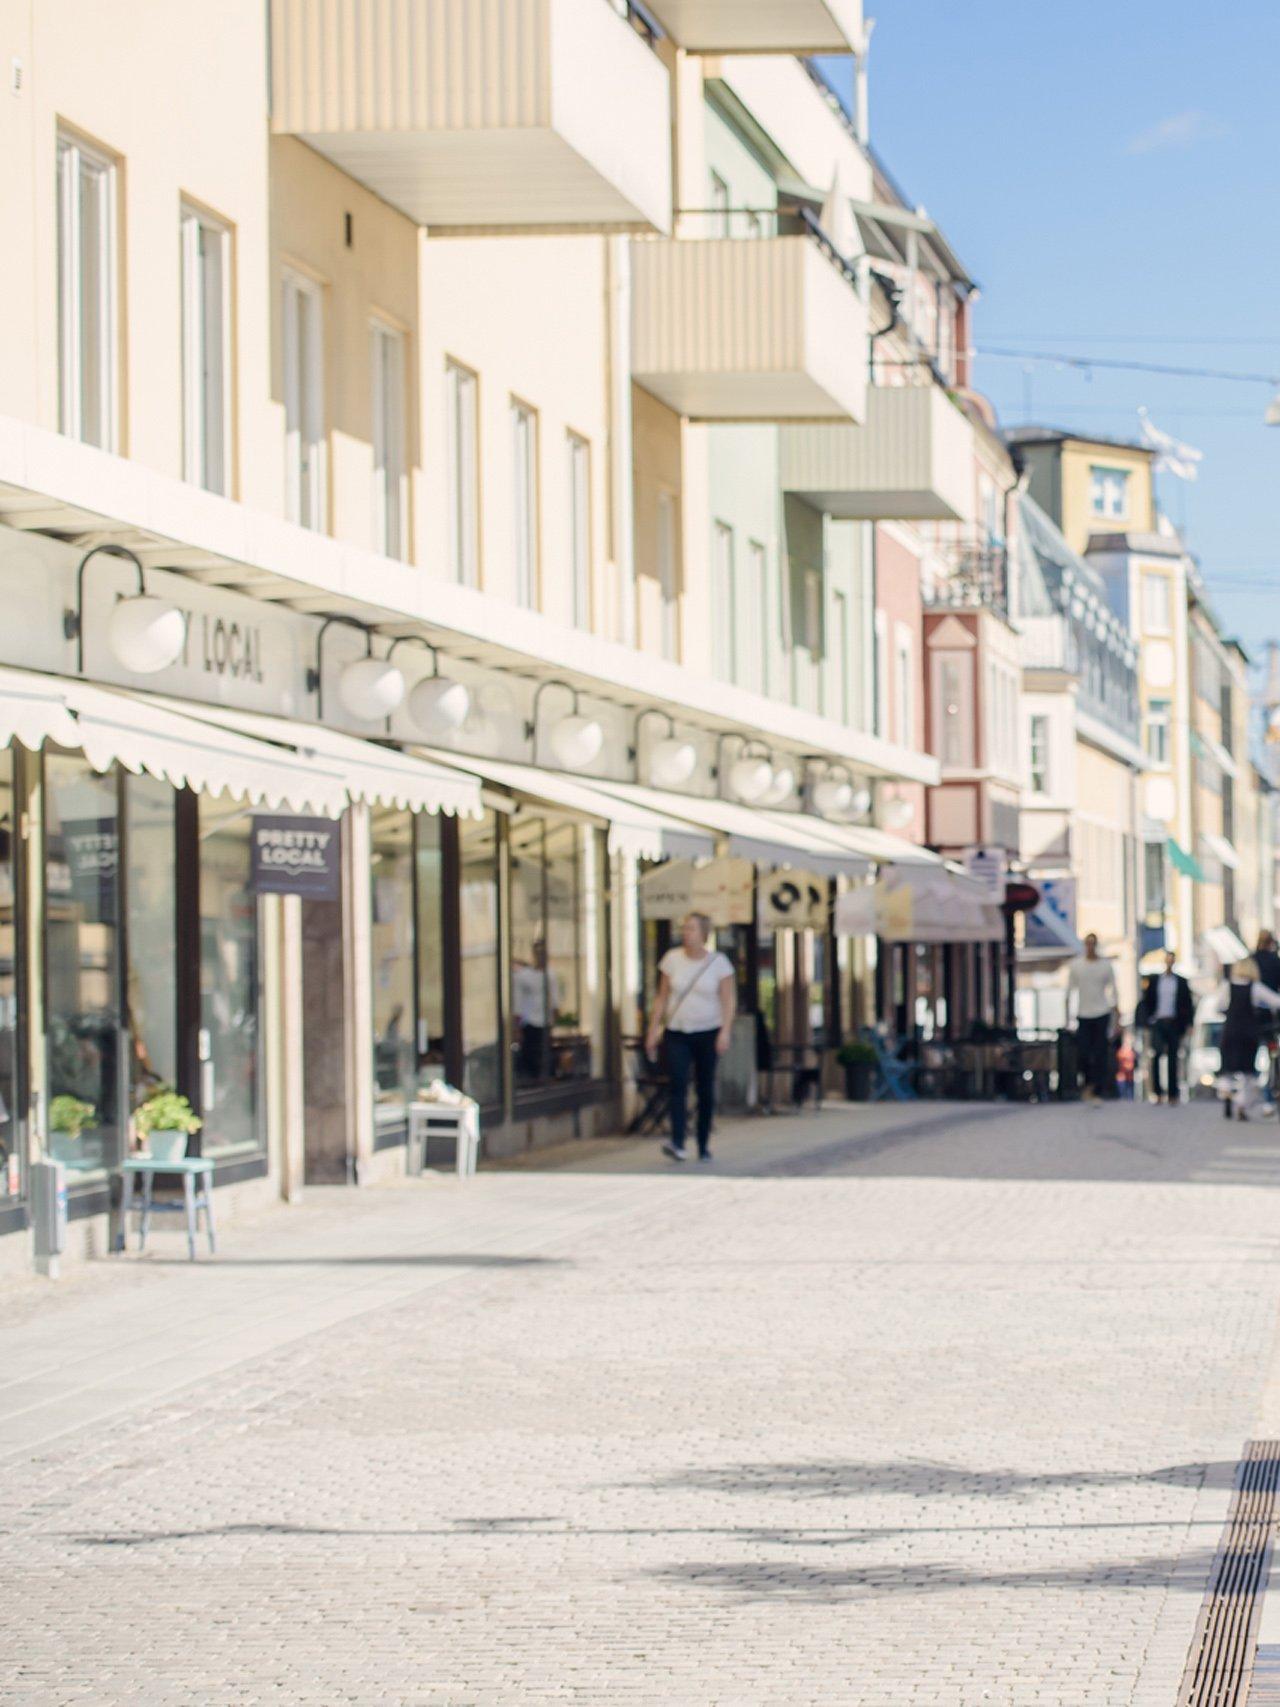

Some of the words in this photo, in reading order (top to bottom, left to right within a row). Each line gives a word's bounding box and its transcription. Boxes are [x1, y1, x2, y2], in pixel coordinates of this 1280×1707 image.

[203, 614, 263, 684] LOCAL
[257, 829, 330, 849] PRETTY
[261, 846, 326, 866] LOCAL
